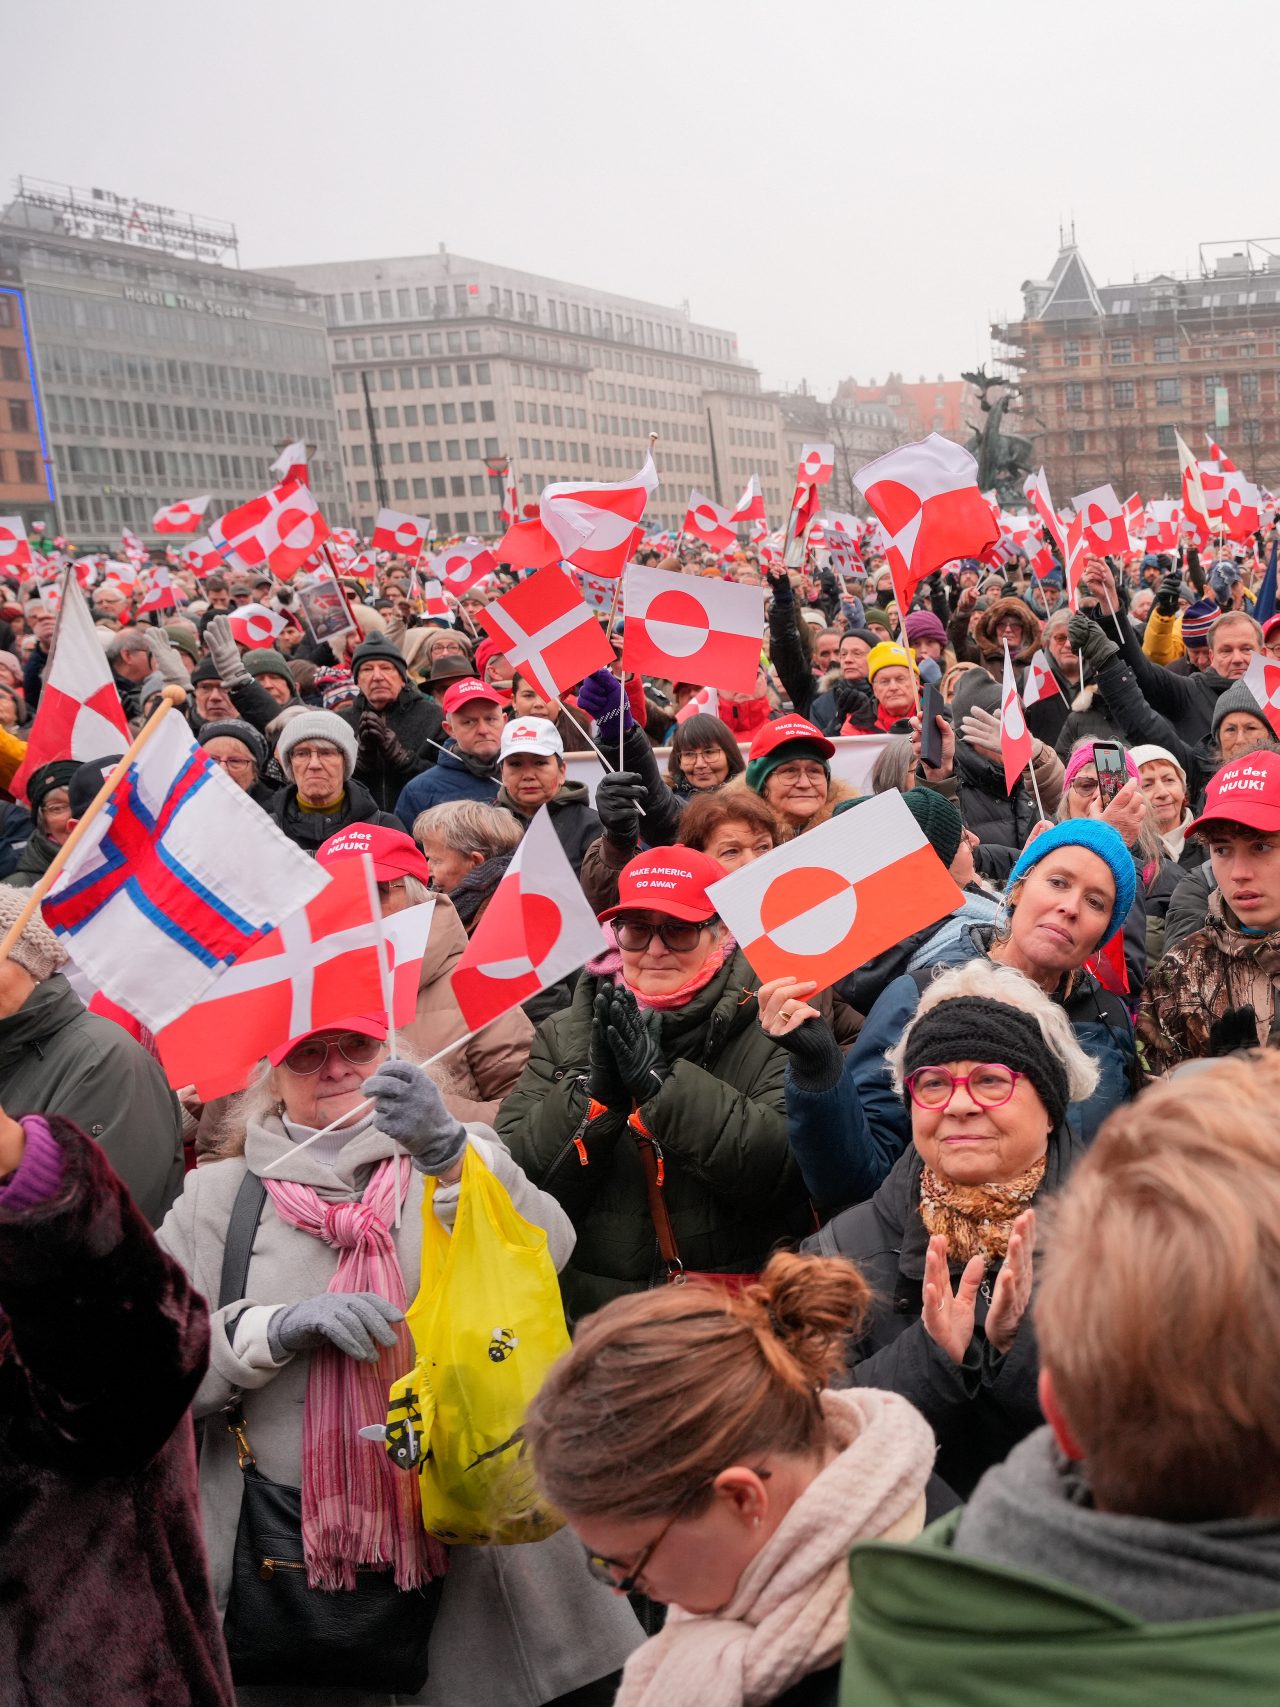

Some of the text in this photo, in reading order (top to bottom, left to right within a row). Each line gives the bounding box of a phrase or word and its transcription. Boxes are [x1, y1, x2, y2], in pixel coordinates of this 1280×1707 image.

[105, 190, 129, 205] The
[124, 286, 252, 320] Hotel The Square
[458, 682, 469, 690] Nu
[459, 685, 485, 694] NUUK!
[775, 723, 817, 733] MAKE AMERICA
[1222, 766, 1268, 782] Nu det
[1218, 779, 1265, 795] NUUK!
[331, 831, 373, 846] Nu det
[327, 841, 370, 856] NUUK!
[629, 867, 693, 879] MAKE AMERICA
[636, 880, 678, 889] GO AWAY
